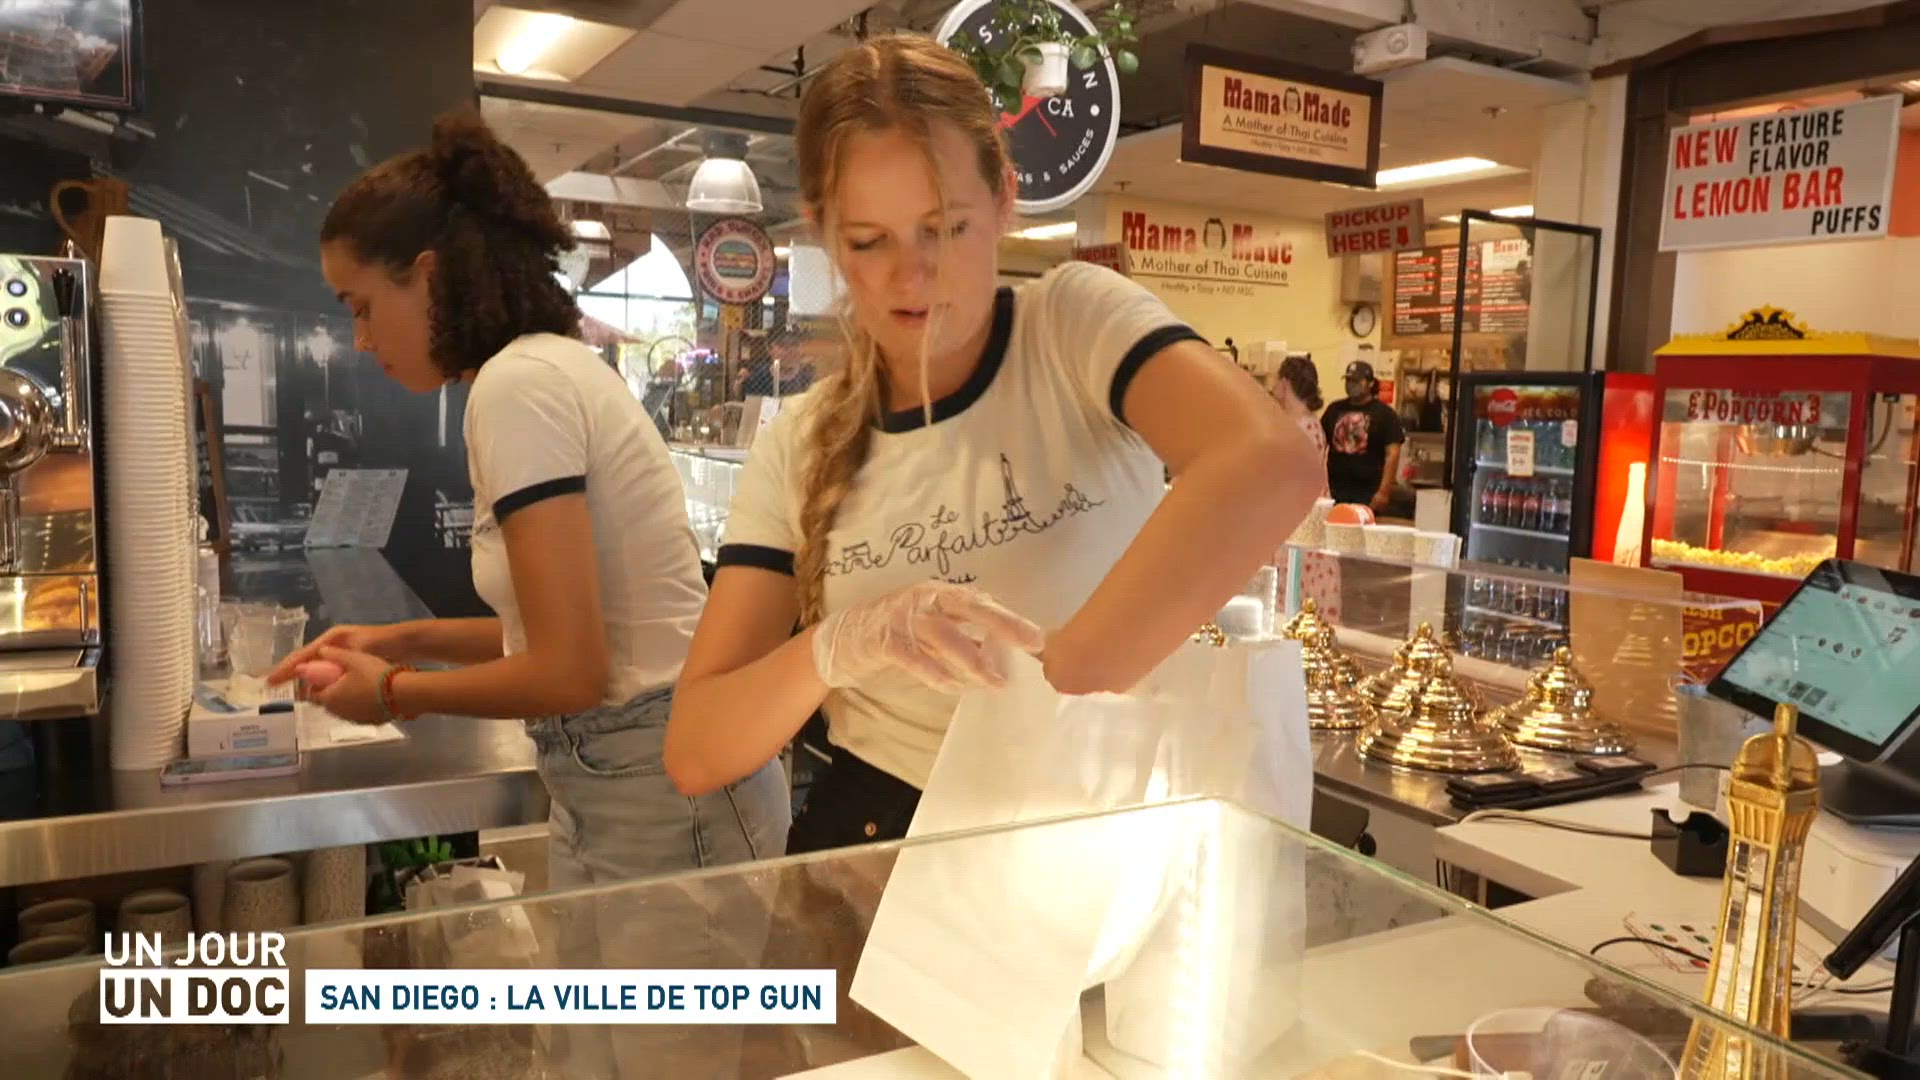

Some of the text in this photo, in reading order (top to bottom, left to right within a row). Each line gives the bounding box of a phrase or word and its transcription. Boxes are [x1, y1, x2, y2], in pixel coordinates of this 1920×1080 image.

[1047, 98, 1075, 118] CA
[1223, 76, 1351, 128] Mama Made
[1223, 114, 1348, 145] A Mother of Thai Cuisine
[1675, 109, 1845, 170] NEW FEATURE
[1059, 128, 1095, 174] SAUCES
[1749, 140, 1830, 175] FLAVOR
[1674, 167, 1845, 220] LEMON BAR
[1122, 211, 1197, 254] Mama
[1331, 204, 1410, 230] PICKUP
[1811, 204, 1882, 236] PUFFS
[1332, 228, 1392, 253] HERE
[1141, 256, 1190, 273] Mother
[1195, 259, 1209, 274] of
[1212, 259, 1240, 276] Thai
[1244, 263, 1288, 281] Cuisine
[930, 505, 959, 530] Le
